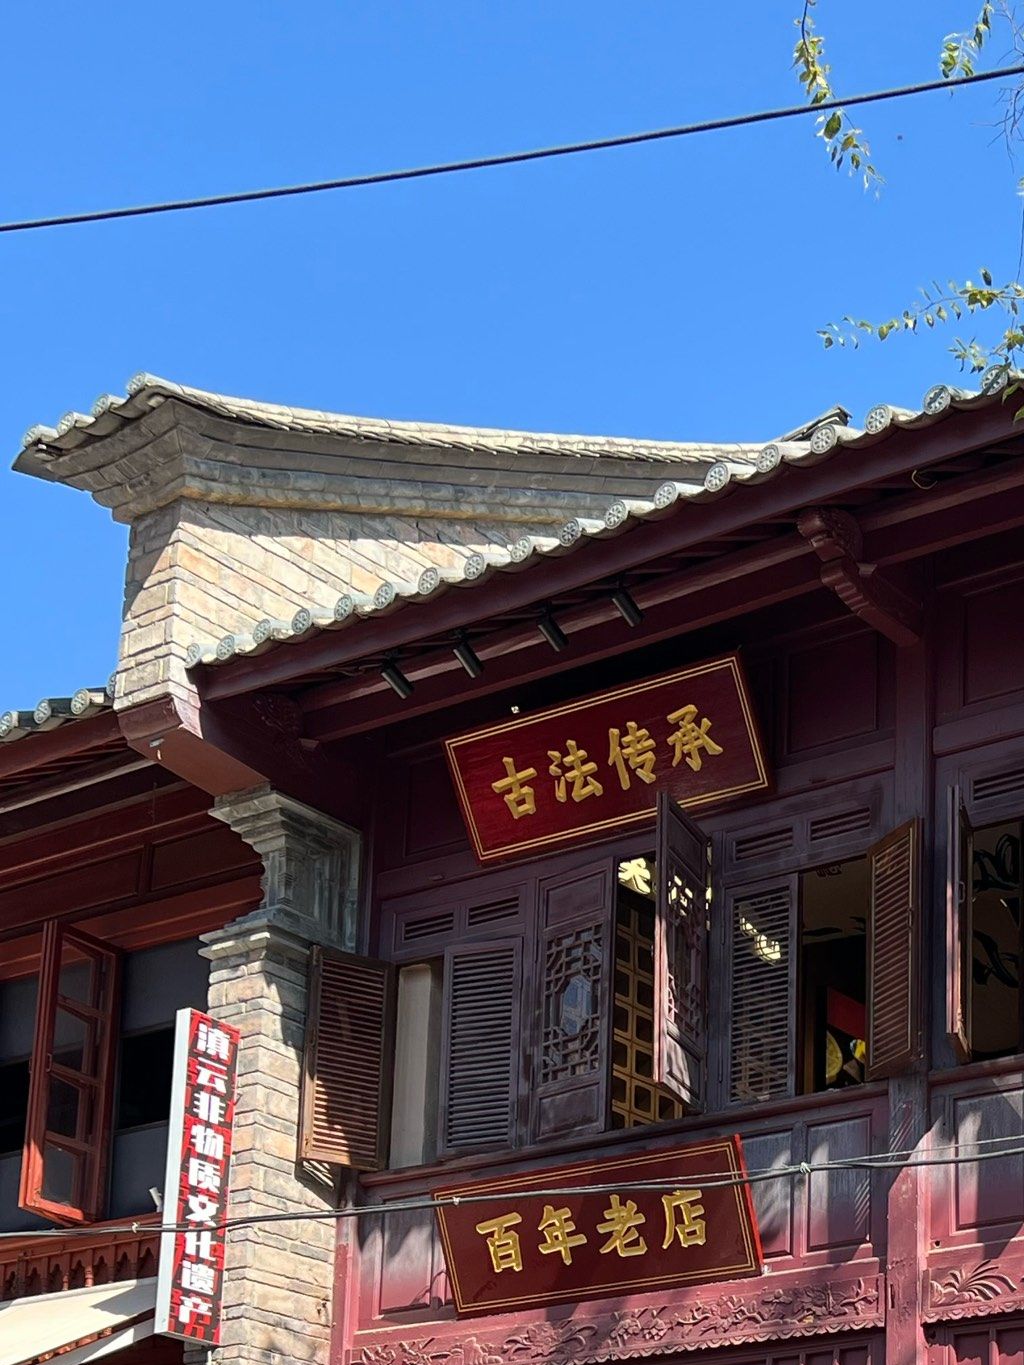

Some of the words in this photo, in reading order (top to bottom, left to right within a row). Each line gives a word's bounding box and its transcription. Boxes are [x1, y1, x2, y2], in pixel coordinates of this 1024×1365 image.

[491, 704, 724, 820] 古法传承
[178, 1022, 230, 1324] 滇云非物质文化遗产
[476, 1189, 706, 1273] 百年老店
